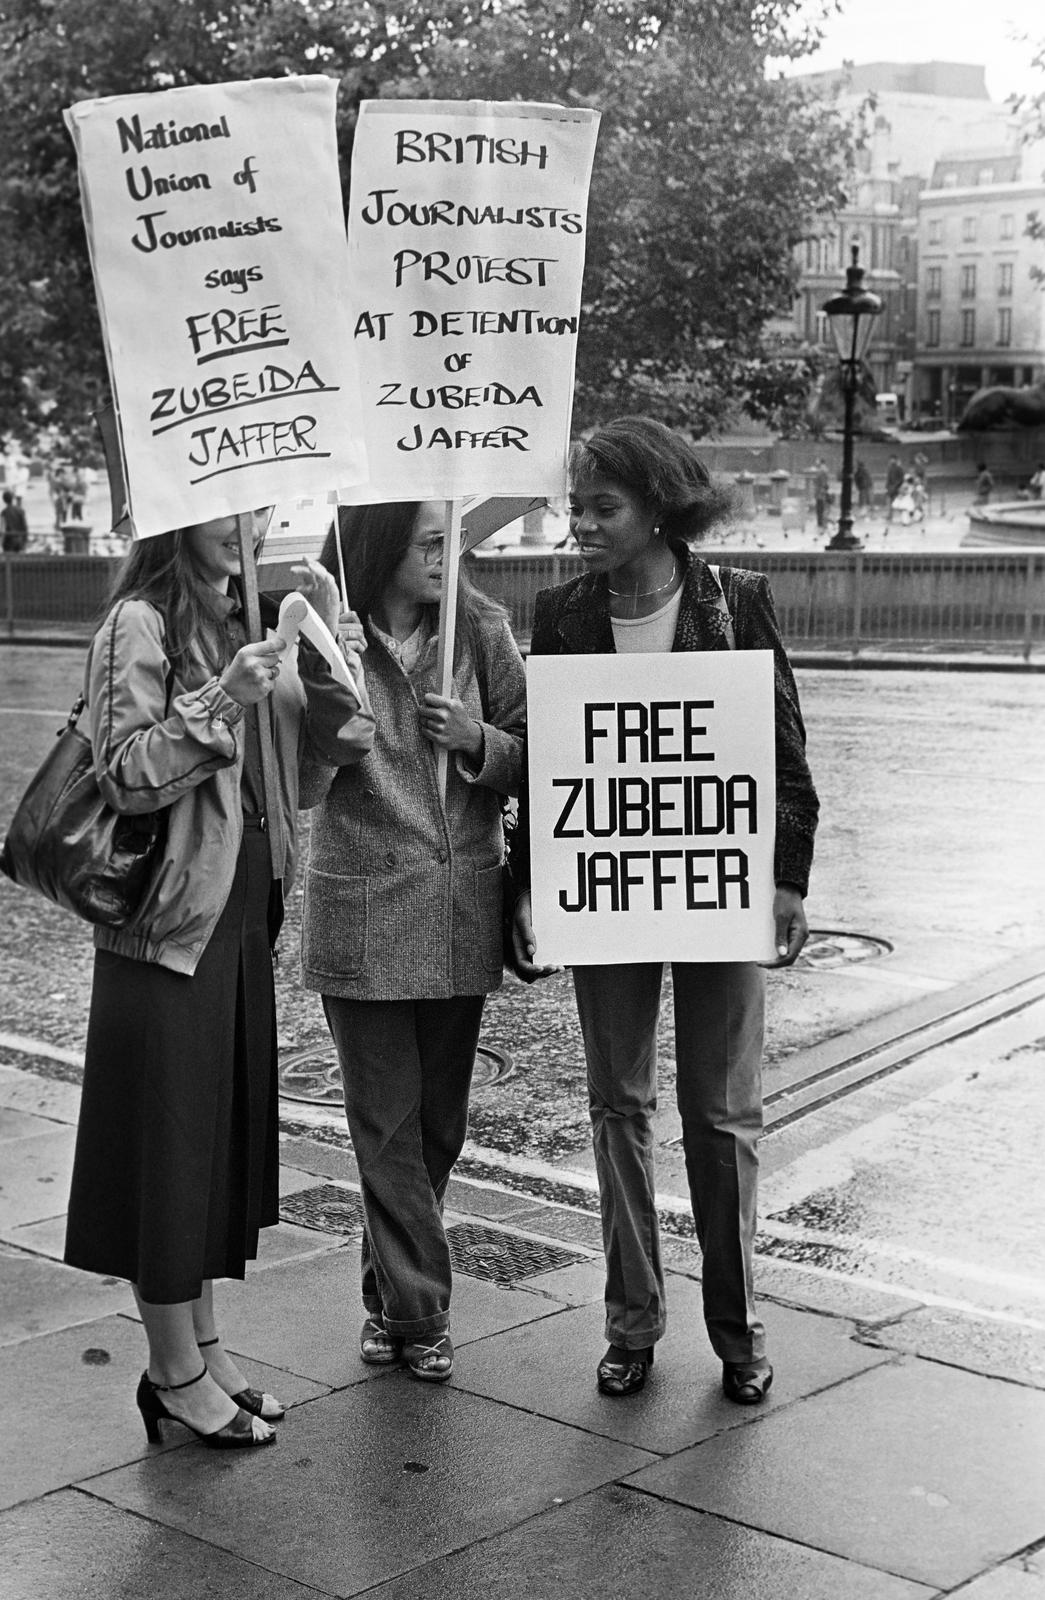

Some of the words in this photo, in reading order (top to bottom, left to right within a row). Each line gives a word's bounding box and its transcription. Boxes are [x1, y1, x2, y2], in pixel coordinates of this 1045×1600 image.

[117, 114, 230, 153] National
[395, 130, 548, 169] BRITISH
[126, 166, 211, 201] Union
[233, 156, 258, 193] of
[132, 211, 282, 253] Journalists
[362, 189, 582, 233] JOURNALISTS
[205, 266, 263, 294] says
[394, 249, 558, 287] PROTEST
[186, 304, 287, 354] FREE
[354, 311, 393, 341] AT
[409, 310, 577, 337] DETENTION
[444, 353, 472, 372] OF
[151, 360, 326, 421] ZUBEIDA
[376, 382, 543, 409] ZUBEIDA
[189, 415, 317, 465] JAFFER
[397, 424, 528, 451] JAFFER
[585, 700, 715, 764] FREE
[552, 775, 757, 838] ZUBEIDA
[559, 849, 749, 912] JAFFER
